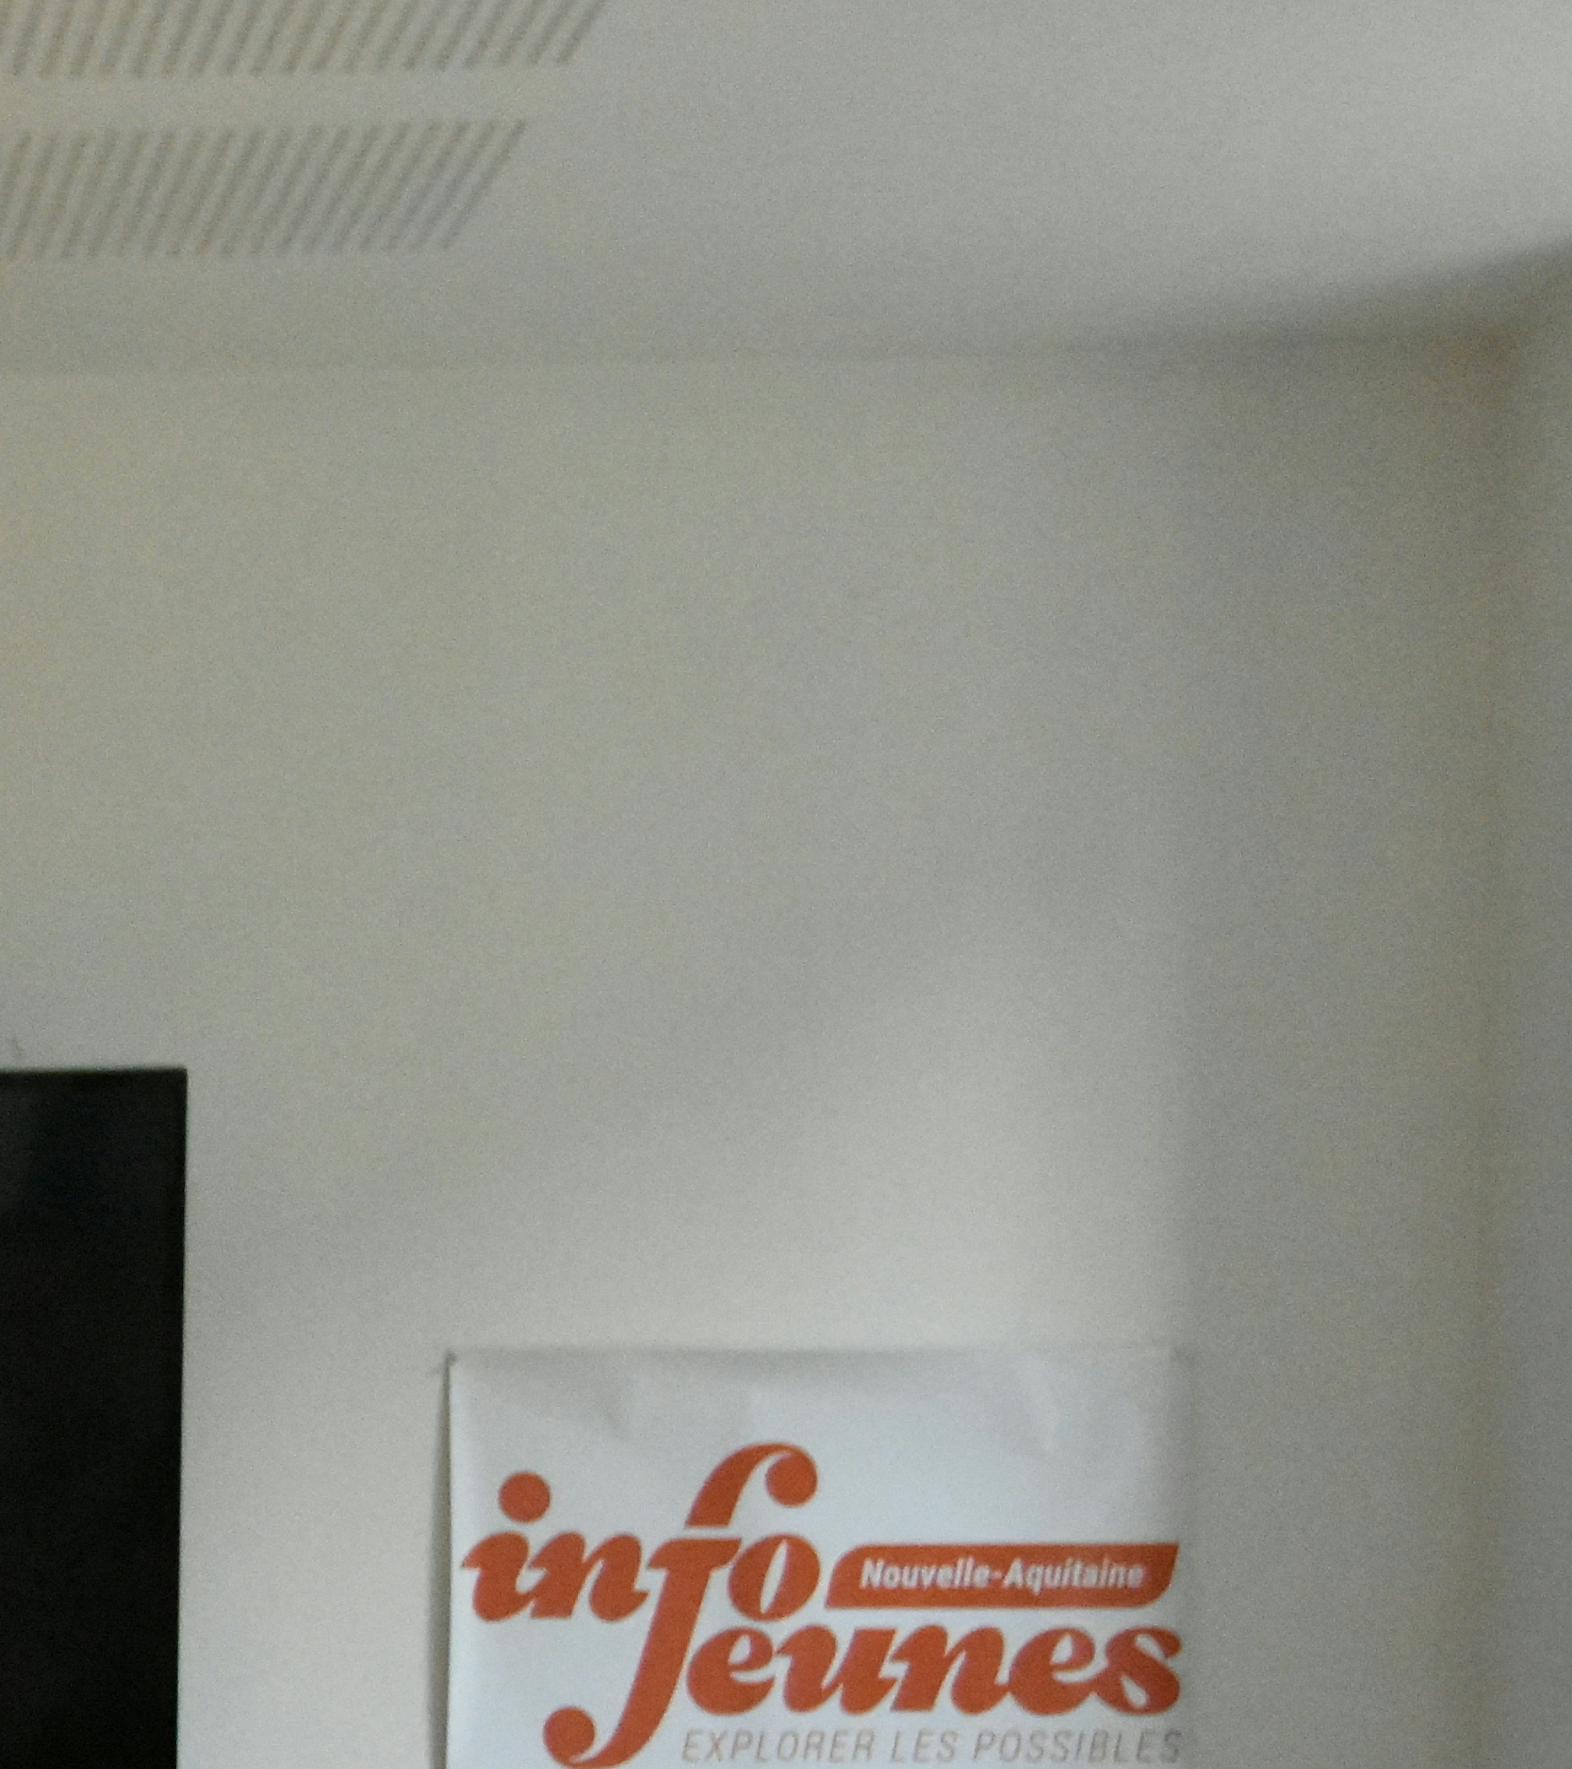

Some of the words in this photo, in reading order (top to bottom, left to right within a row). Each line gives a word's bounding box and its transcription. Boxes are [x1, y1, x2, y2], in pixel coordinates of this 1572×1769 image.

[462, 1442, 822, 1622] info
[860, 1556, 1145, 1596] Nouvelle-Aquitaine
[682, 1728, 875, 1764] EXPLORER
[891, 1728, 959, 1764] LES
[973, 1728, 1182, 1764] POSSIBLES
